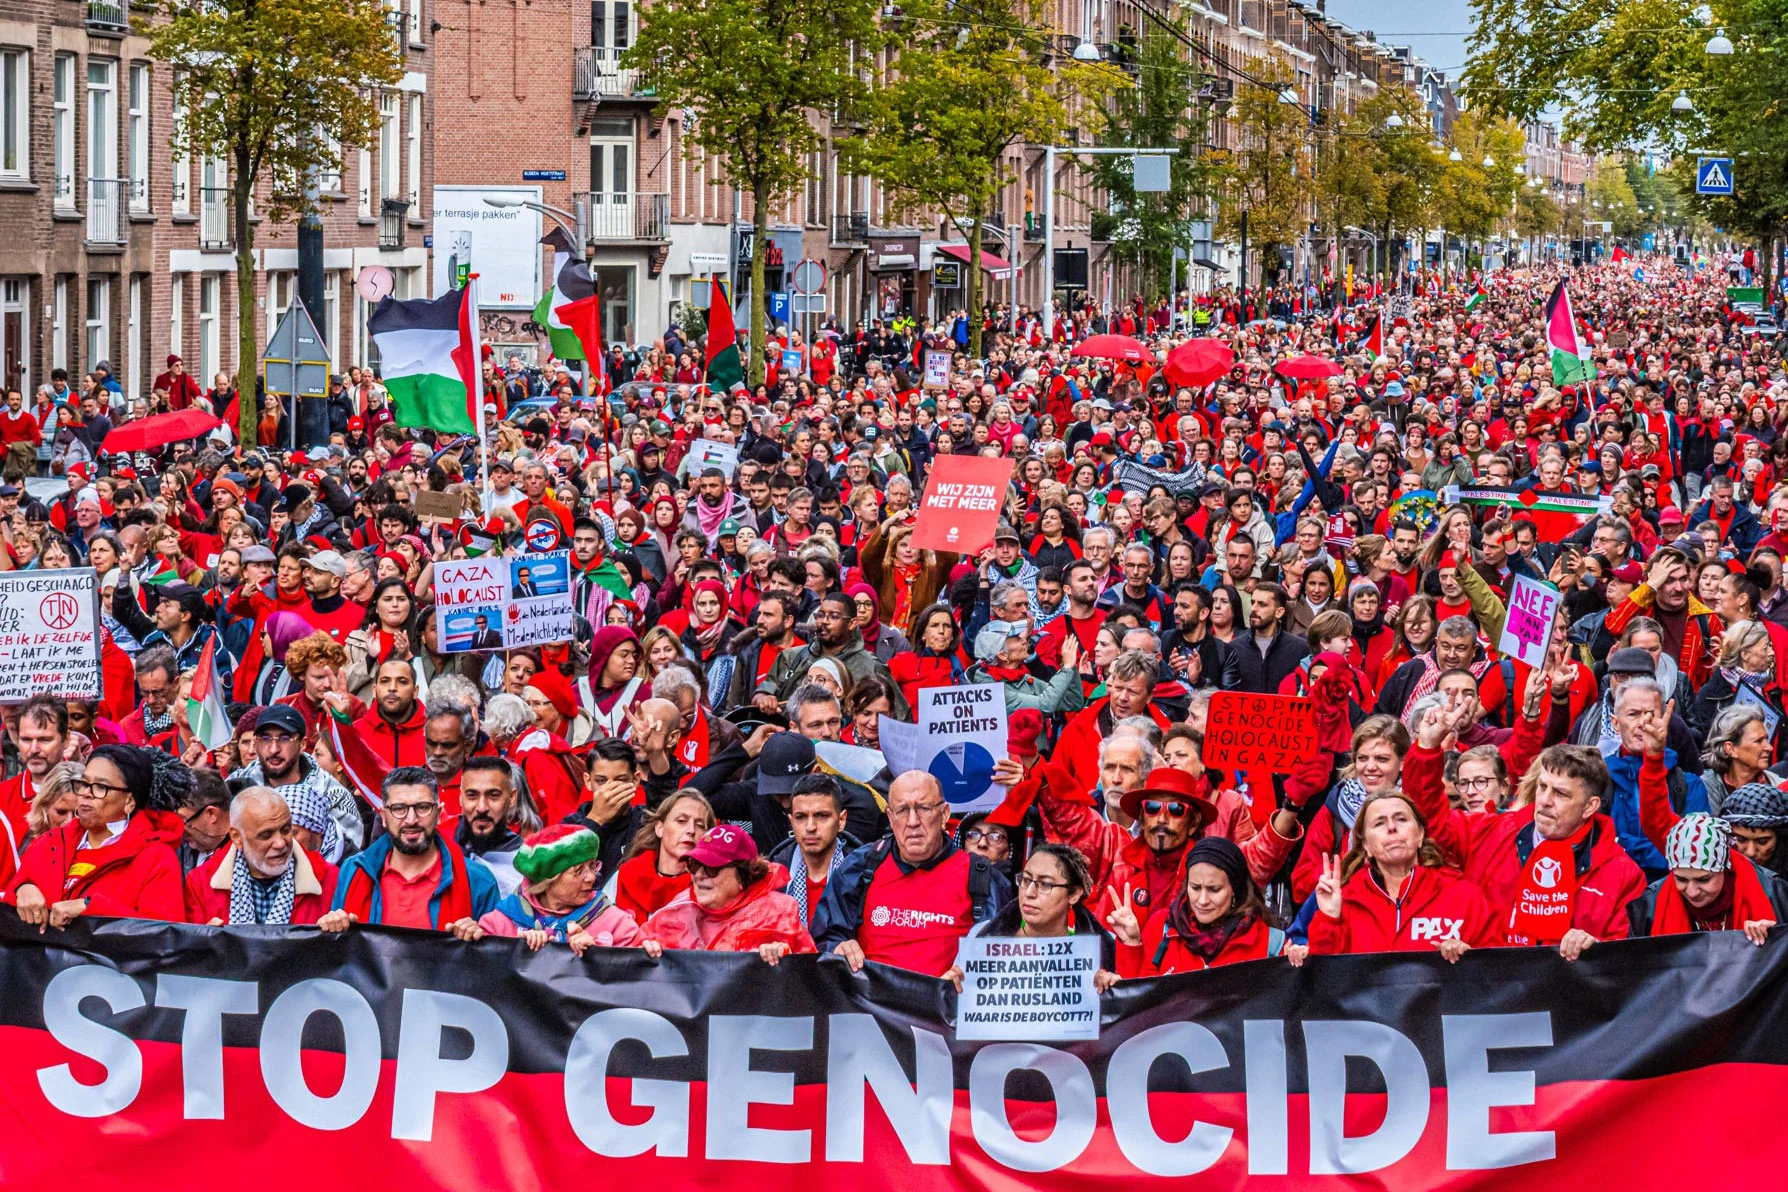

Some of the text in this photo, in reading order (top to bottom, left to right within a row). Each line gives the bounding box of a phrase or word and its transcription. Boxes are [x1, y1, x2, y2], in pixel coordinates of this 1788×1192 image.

[445, 209, 479, 220] terrasje
[775, 301, 784, 313] P
[937, 483, 996, 498] WIJ ZIJN
[1464, 491, 1509, 499] PALESTINE
[926, 495, 997, 511] MET MEER
[1547, 496, 1593, 507] PALESTINE
[442, 566, 494, 583] GAZA
[436, 585, 504, 607] HOLOCAUST
[1514, 581, 1554, 622] NEE
[530, 600, 573, 619] Nederlandse
[507, 618, 574, 646] Medeplichtigheid
[12, 647, 46, 660] LAAT
[65, 646, 84, 657] ME
[32, 673, 64, 684] VREDE
[932, 688, 993, 706] ATTACKS
[953, 705, 974, 719] ON
[928, 717, 998, 735] PATIENTS
[1208, 728, 1313, 752] HOLOCAUST
[1210, 744, 1304, 769] IN GAZA
[1522, 888, 1569, 903] Save the
[1520, 901, 1568, 916] Children
[890, 917, 927, 929] FORUM
[1411, 917, 1464, 940] PAX
[986, 942, 1073, 957] ISRAEL: 12X
[965, 958, 1093, 973] MEER AANVALLEN
[976, 972, 1082, 990] OP PATIËNTEN
[976, 992, 1082, 1006] DAN RUSLAND
[964, 1011, 1093, 1022] WAAR IS DE BOYCOTT?!
[36, 964, 1557, 1176] STOP GENOCIDE
